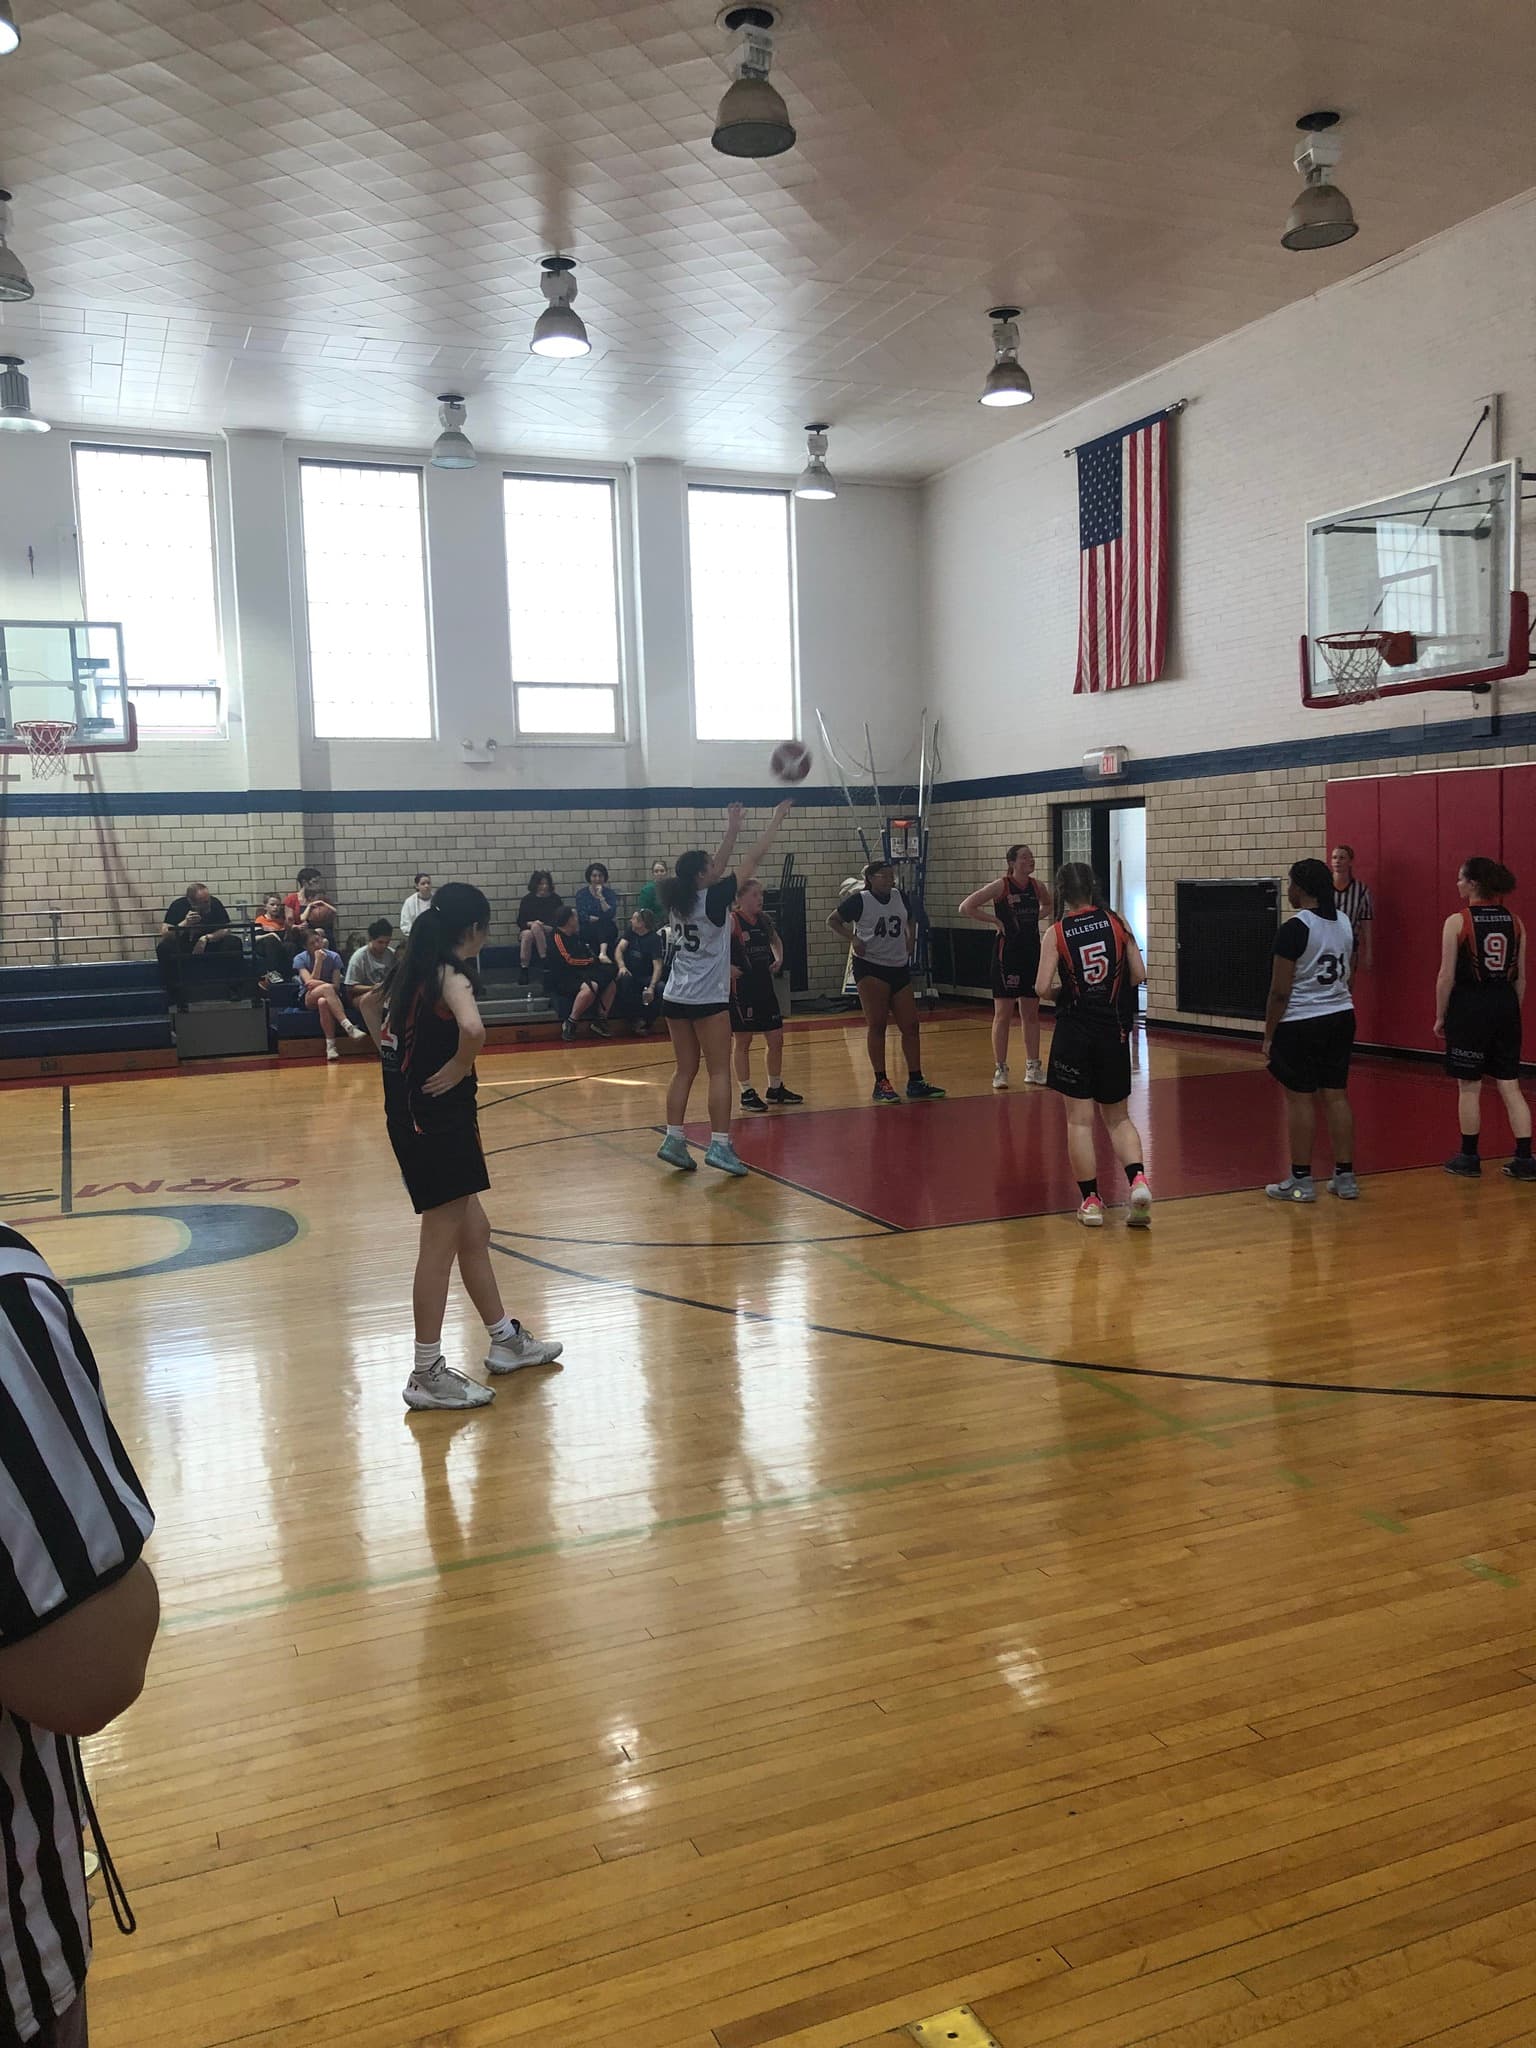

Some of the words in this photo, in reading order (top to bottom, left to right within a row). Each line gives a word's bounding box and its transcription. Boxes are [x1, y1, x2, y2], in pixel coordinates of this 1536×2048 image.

[671, 923, 701, 952] 25
[873, 915, 902, 938] 43
[1065, 920, 1110, 938] KILLESTER
[1079, 941, 1109, 985] 5
[1483, 932, 1508, 972] 9
[1316, 953, 1346, 986] 31
